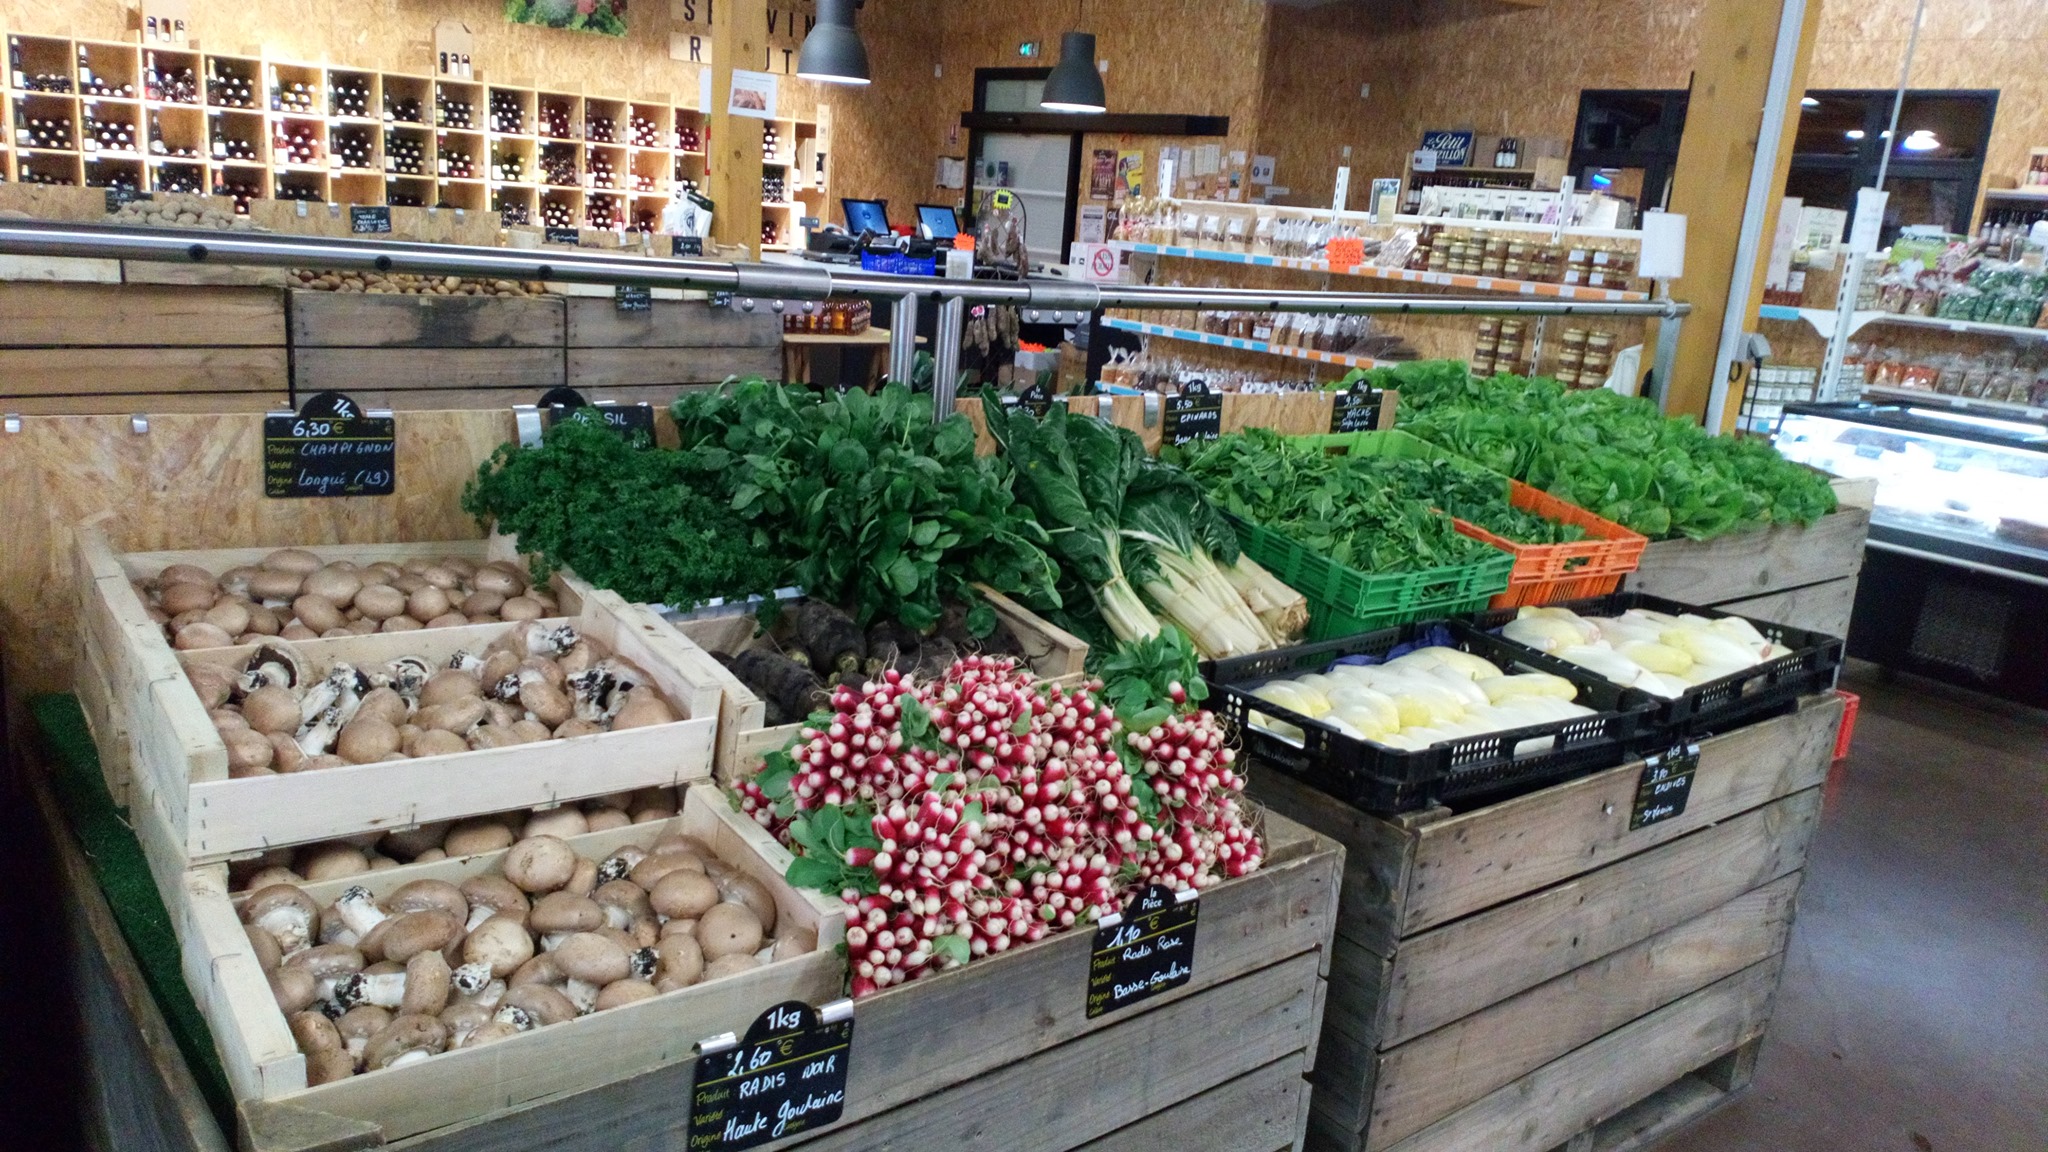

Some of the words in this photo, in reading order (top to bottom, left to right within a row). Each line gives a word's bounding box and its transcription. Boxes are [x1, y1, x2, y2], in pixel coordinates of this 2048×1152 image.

[1433, 132, 1465, 149] Petit
[1188, 381, 1202, 393] 1kg
[573, 412, 628, 427] PESIL
[293, 420, 330, 437] 6,30
[1666, 745, 1681, 760] 1kg
[1142, 897, 1162, 910] Pièce
[1106, 924, 1141, 949] 1,10
[1122, 944, 1152, 960] Radis
[767, 1006, 802, 1031] 1kg
[728, 1046, 772, 1077] 2,60
[696, 1088, 730, 1106] Produit
[739, 1072, 786, 1099] RADIS
[801, 1054, 836, 1079] NOIR
[722, 1111, 767, 1142] Haute
